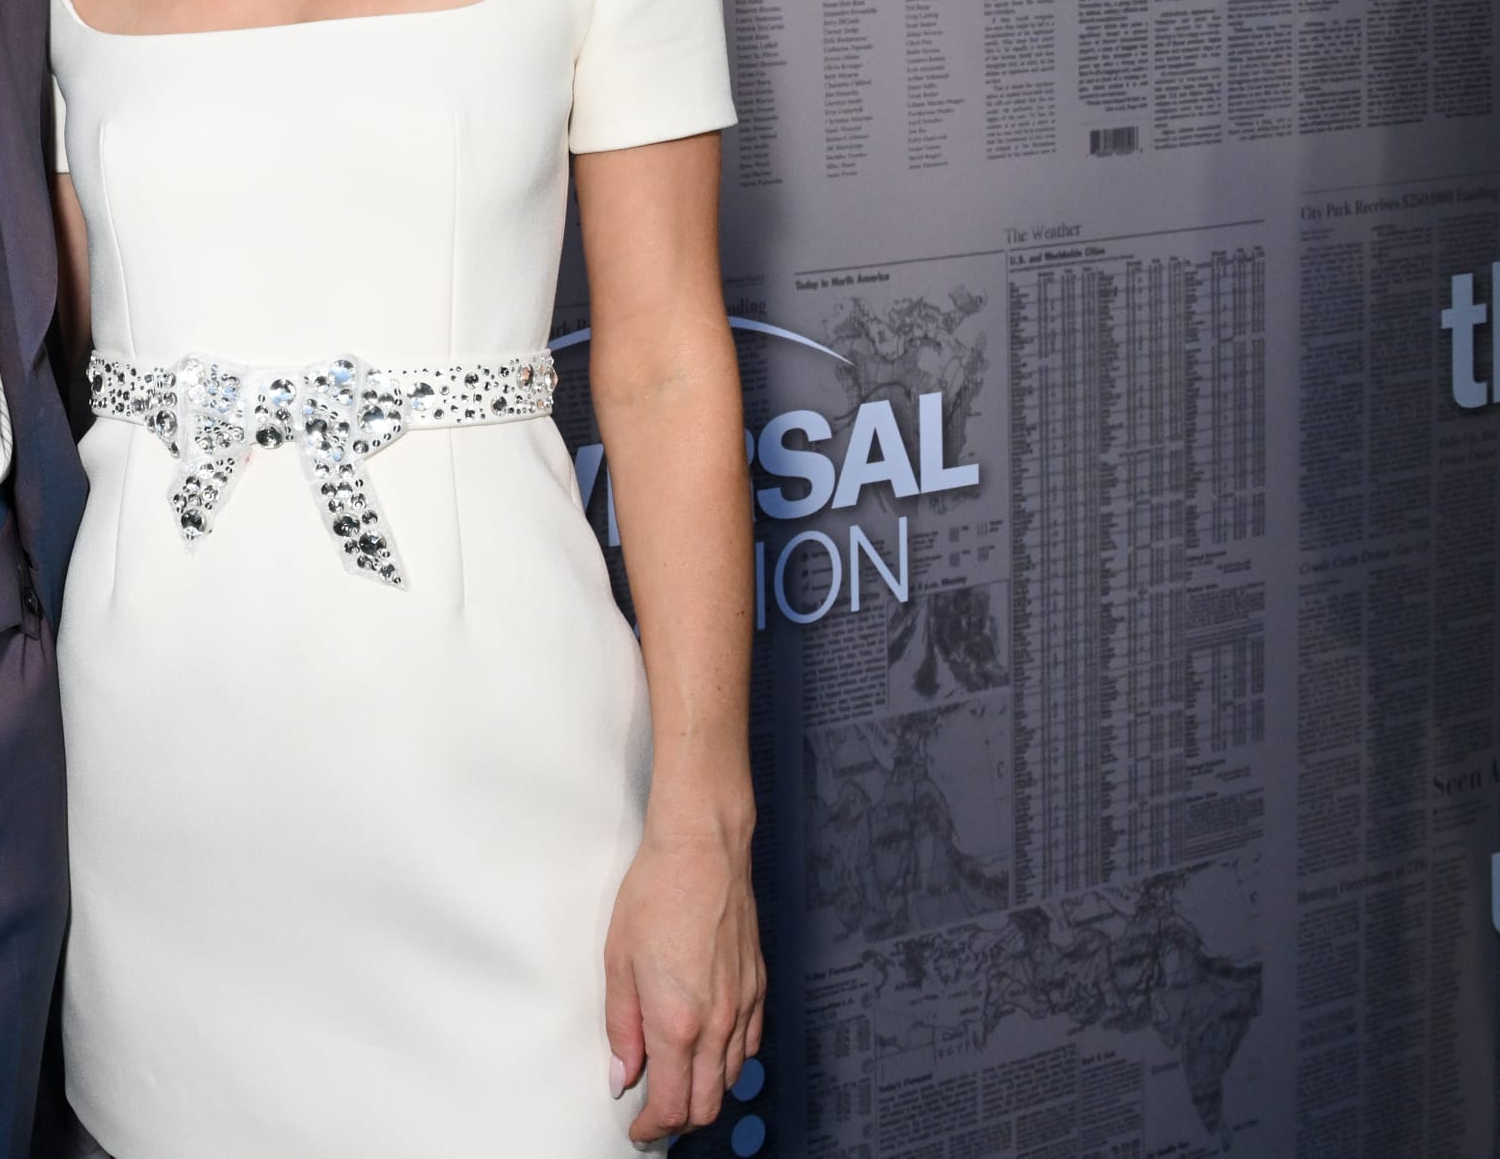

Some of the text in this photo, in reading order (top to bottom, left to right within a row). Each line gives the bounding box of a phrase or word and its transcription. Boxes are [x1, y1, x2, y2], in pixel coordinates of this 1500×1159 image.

[1300, 204, 1325, 223] City
[1326, 201, 1352, 218] Park
[1355, 196, 1400, 215] Receives
[1003, 221, 1082, 245] The Weather
